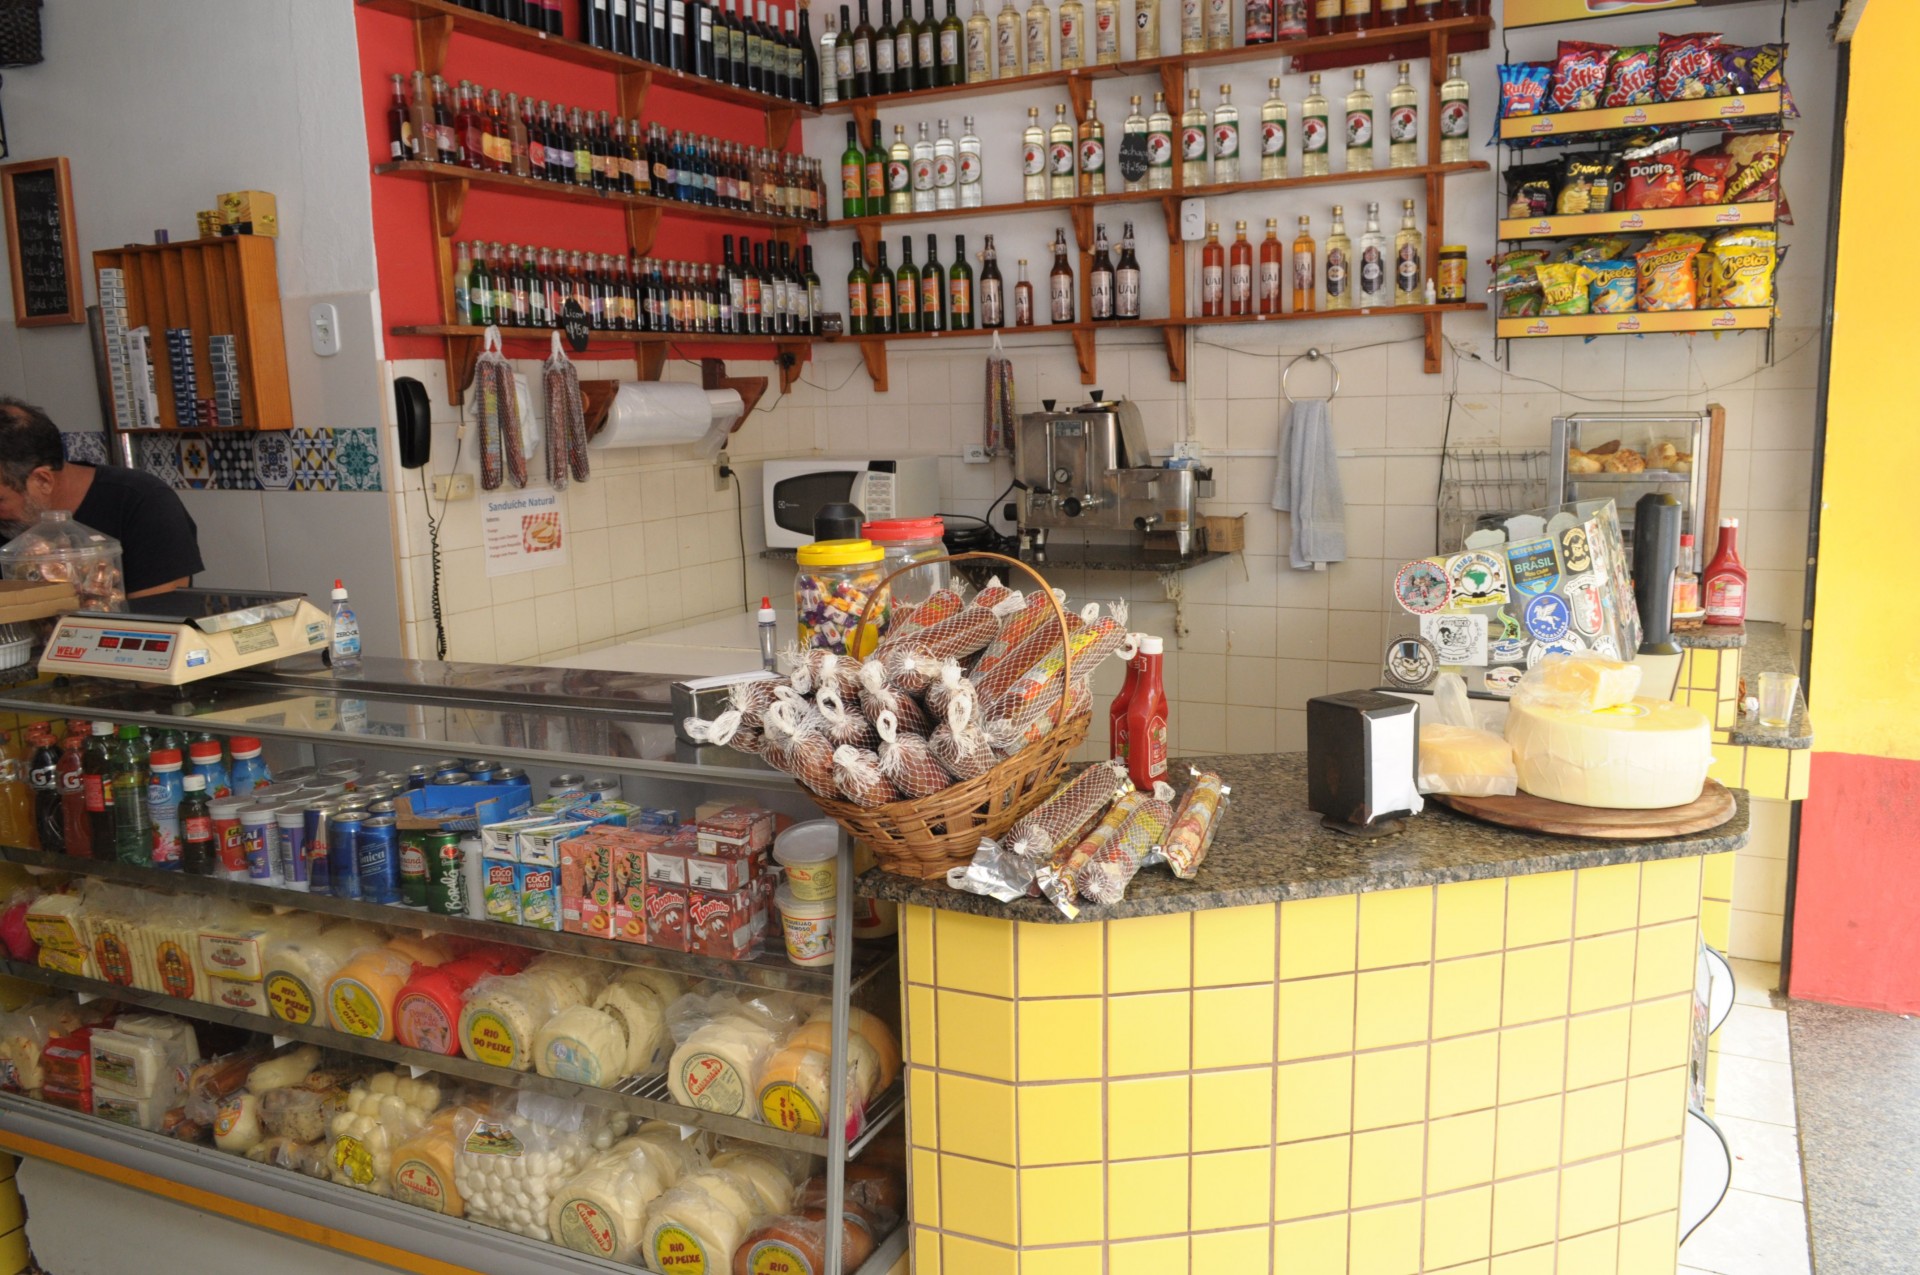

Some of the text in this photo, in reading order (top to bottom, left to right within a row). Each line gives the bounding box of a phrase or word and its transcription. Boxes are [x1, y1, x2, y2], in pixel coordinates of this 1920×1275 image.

[1659, 49, 1711, 99] Ruffles
[1503, 77, 1545, 97] Ruffles
[1551, 64, 1606, 107] Ruffles
[1640, 251, 1689, 276] Cheetos
[1722, 254, 1770, 280] Cheetos
[528, 495, 555, 507] Natural
[1514, 557, 1554, 574] BRASIL
[56, 645, 88, 656] WELMY
[32, 768, 47, 786] G
[63, 770, 81, 789] G
[490, 869, 512, 877] COCO
[526, 875, 550, 884] COCO
[280, 986, 297, 998] RIO
[483, 1027, 500, 1040] RIO
[473, 1036, 512, 1054] DO PEIXE
[669, 1242, 685, 1253] RIO
[661, 1254, 701, 1266] DO PEIXE
[769, 1262, 789, 1272] RIO
